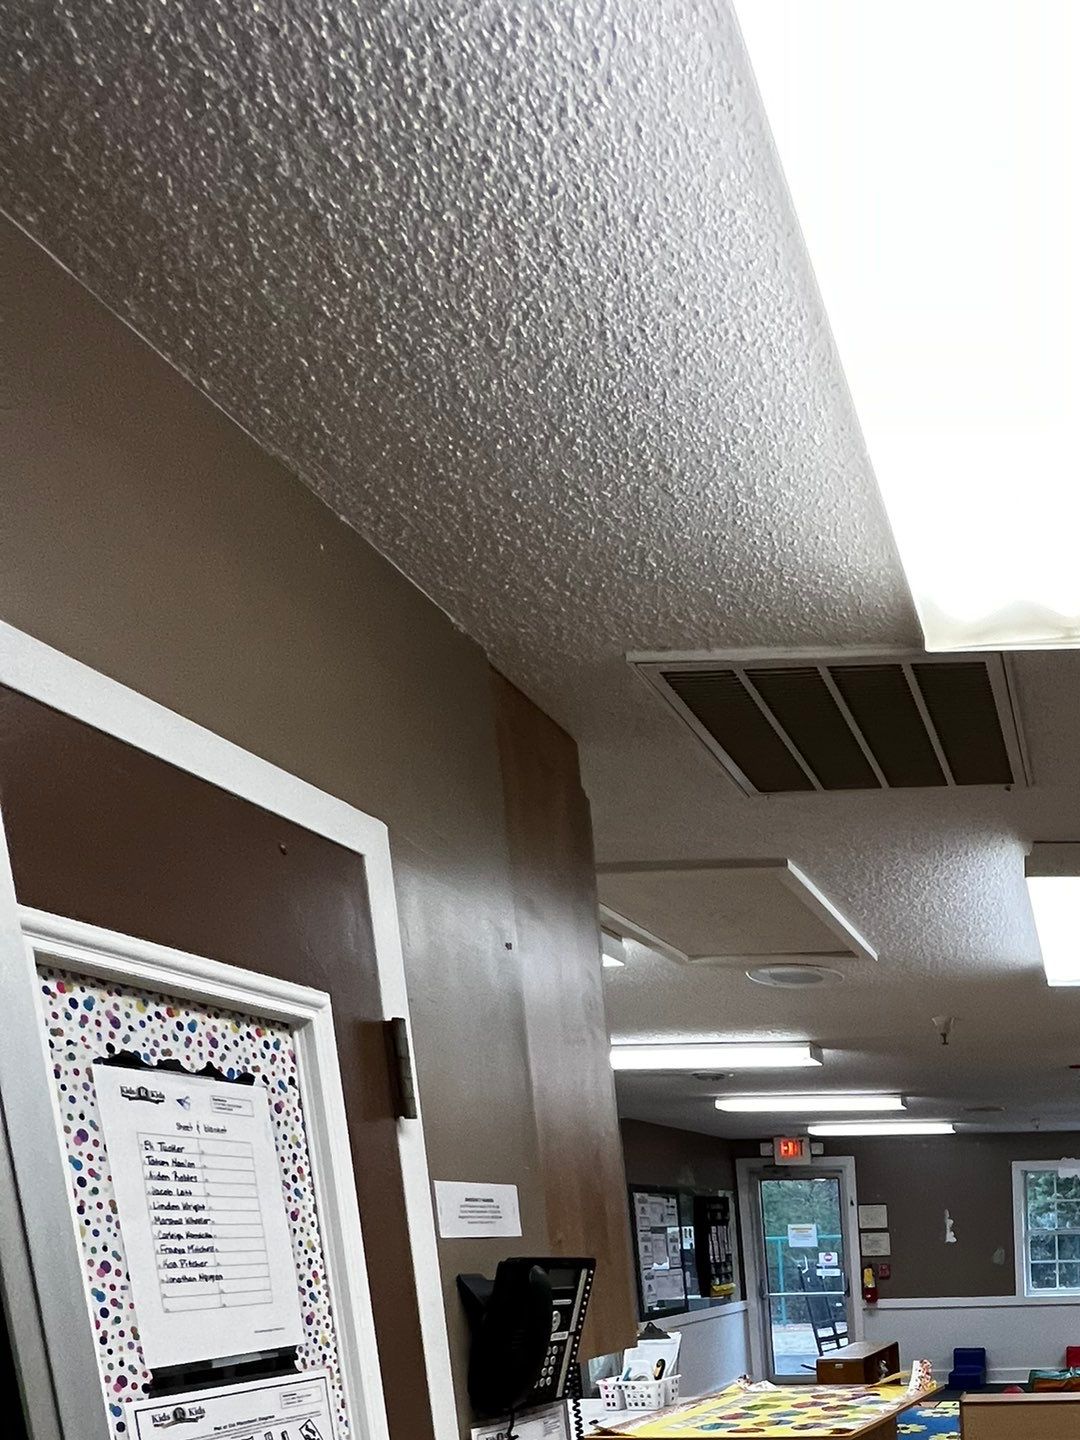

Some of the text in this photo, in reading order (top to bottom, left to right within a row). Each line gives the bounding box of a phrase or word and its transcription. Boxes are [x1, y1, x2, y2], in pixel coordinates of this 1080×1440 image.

[780, 1139, 804, 1156] EXIT
[151, 1412, 170, 1424] Kids
[188, 1406, 206, 1417] Kids
